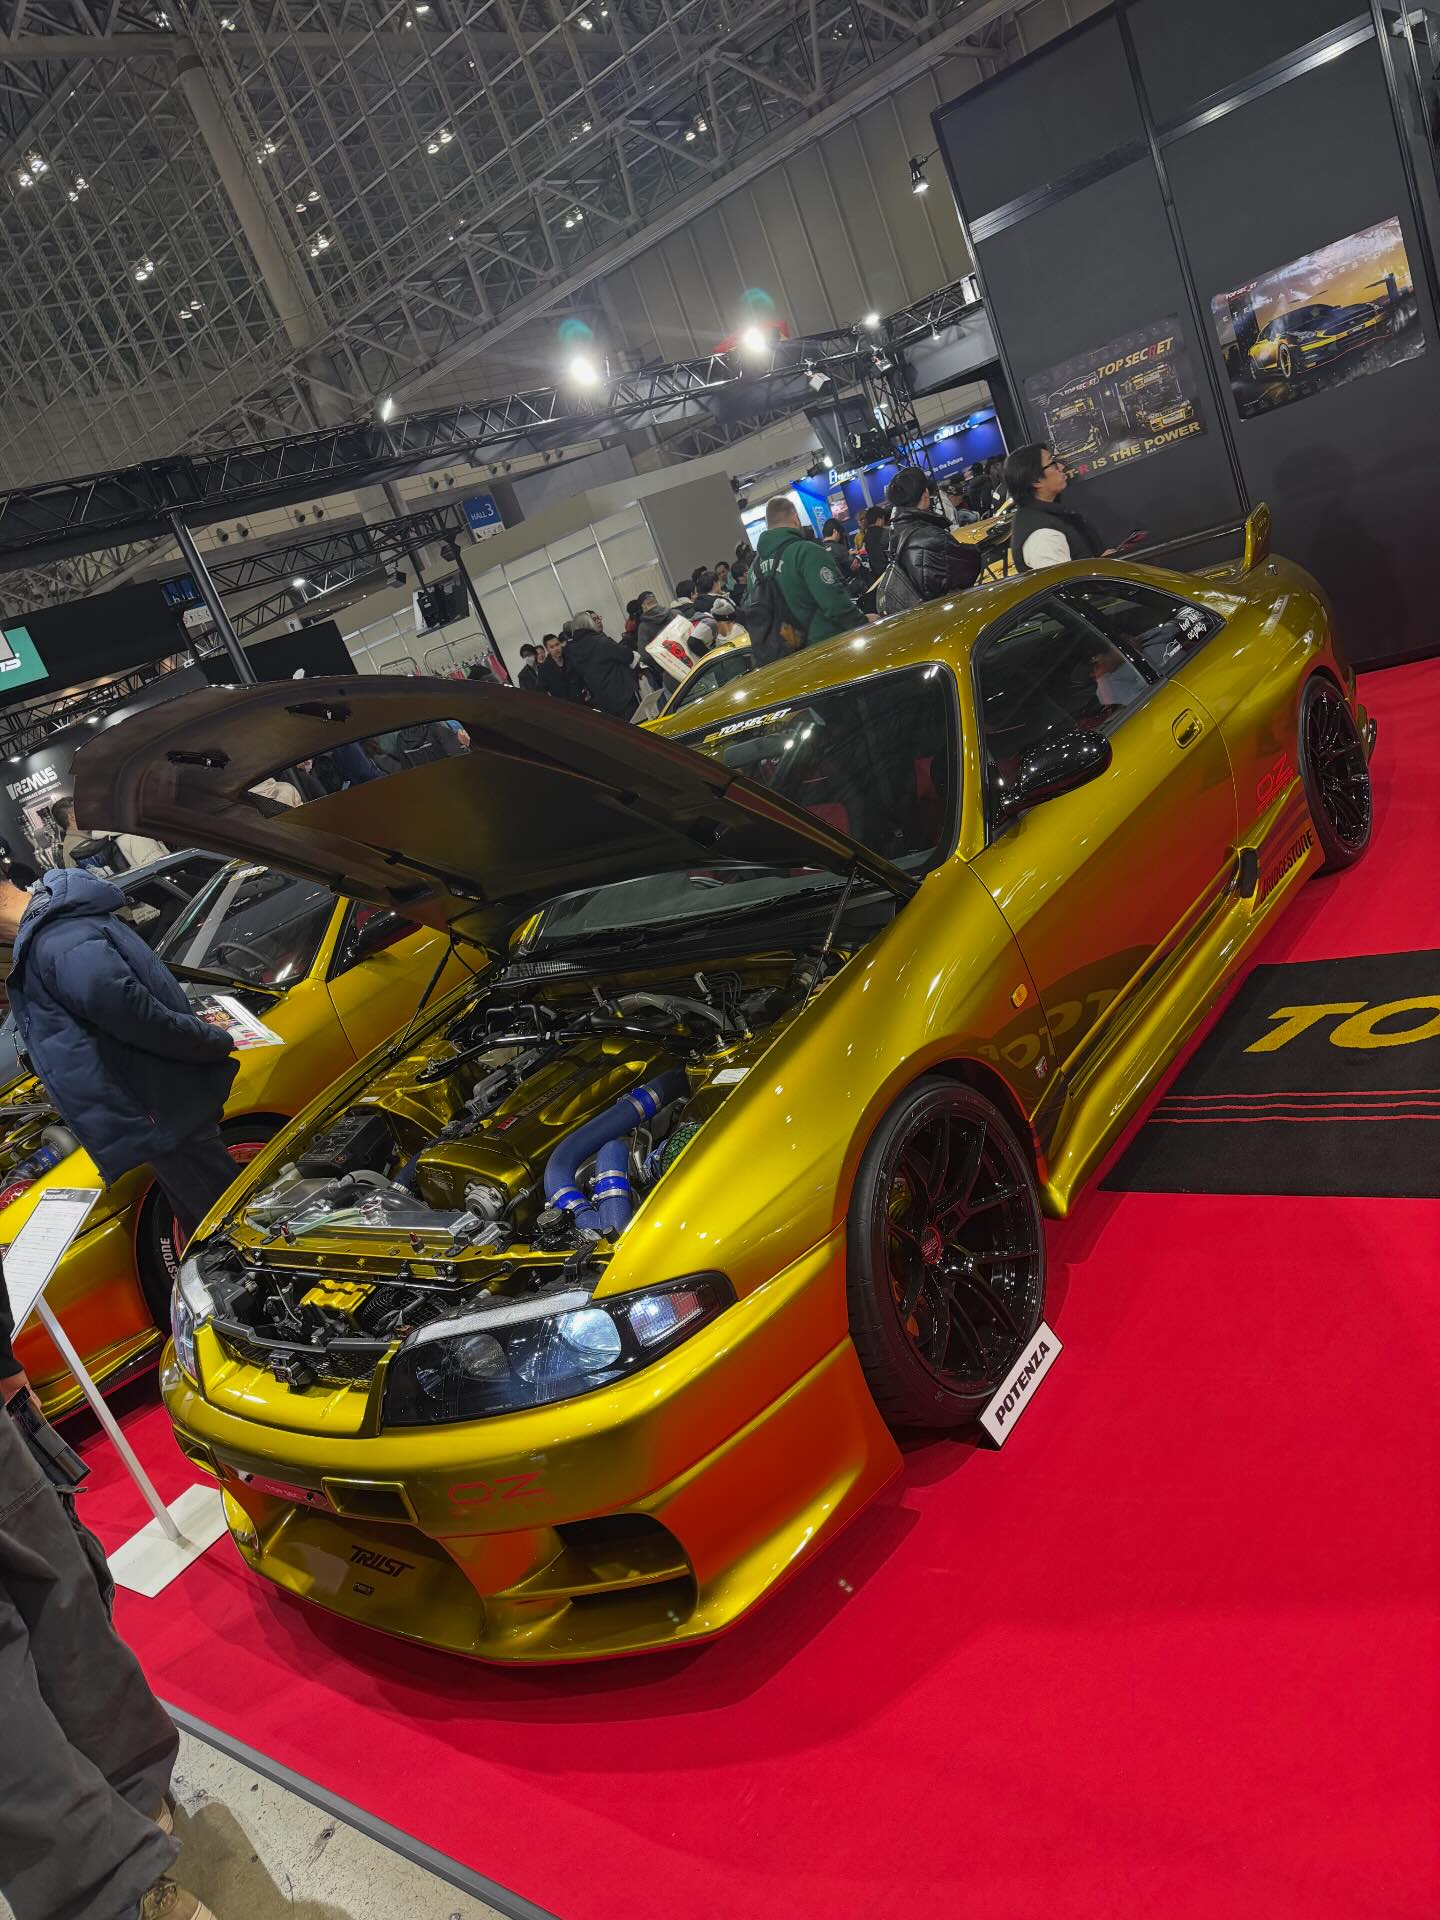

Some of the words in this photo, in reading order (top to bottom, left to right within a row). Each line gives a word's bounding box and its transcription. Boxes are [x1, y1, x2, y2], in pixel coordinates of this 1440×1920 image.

[1092, 457, 1107, 470] IS
[1109, 443, 1141, 462] THE
[1144, 421, 1201, 449] POWER
[470, 511, 488, 521] HALL
[484, 503, 495, 517] 3
[13, 765, 58, 798] REMUS
[1260, 828, 1313, 902] BRIDGESTONE
[995, 1341, 1050, 1426] POTENZA
[351, 1544, 417, 1578] TRUST
